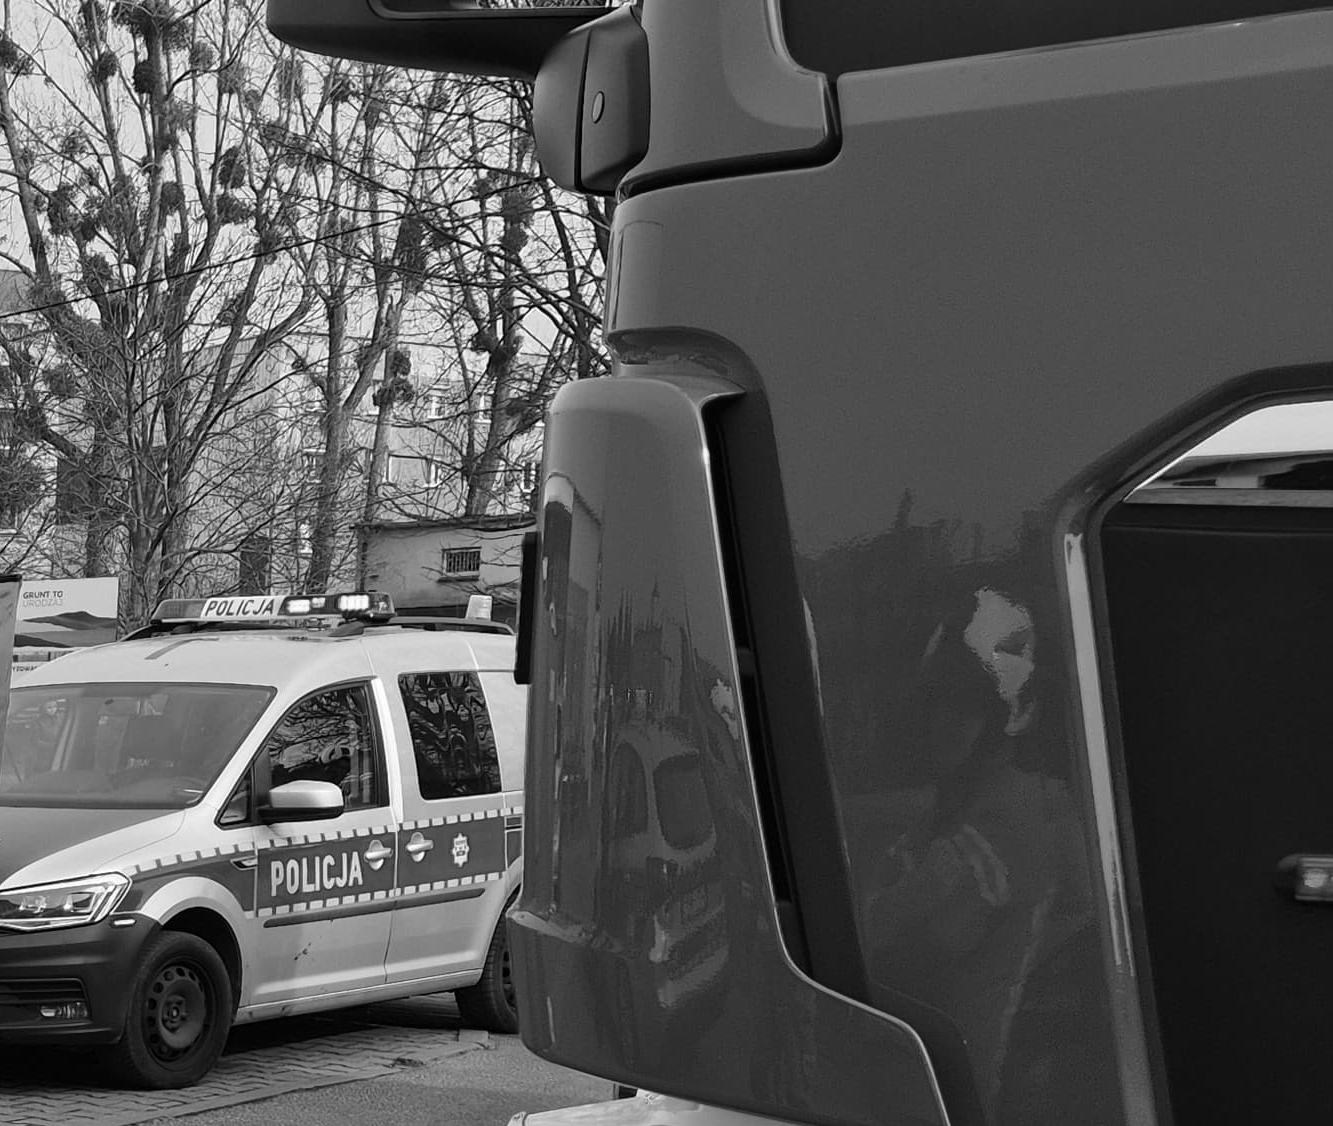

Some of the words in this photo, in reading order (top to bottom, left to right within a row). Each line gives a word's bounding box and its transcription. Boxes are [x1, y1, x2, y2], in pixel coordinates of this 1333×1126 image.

[53, 590, 63, 598] TO
[205, 599, 274, 617] POLICJA
[271, 852, 363, 897] POLICJA
